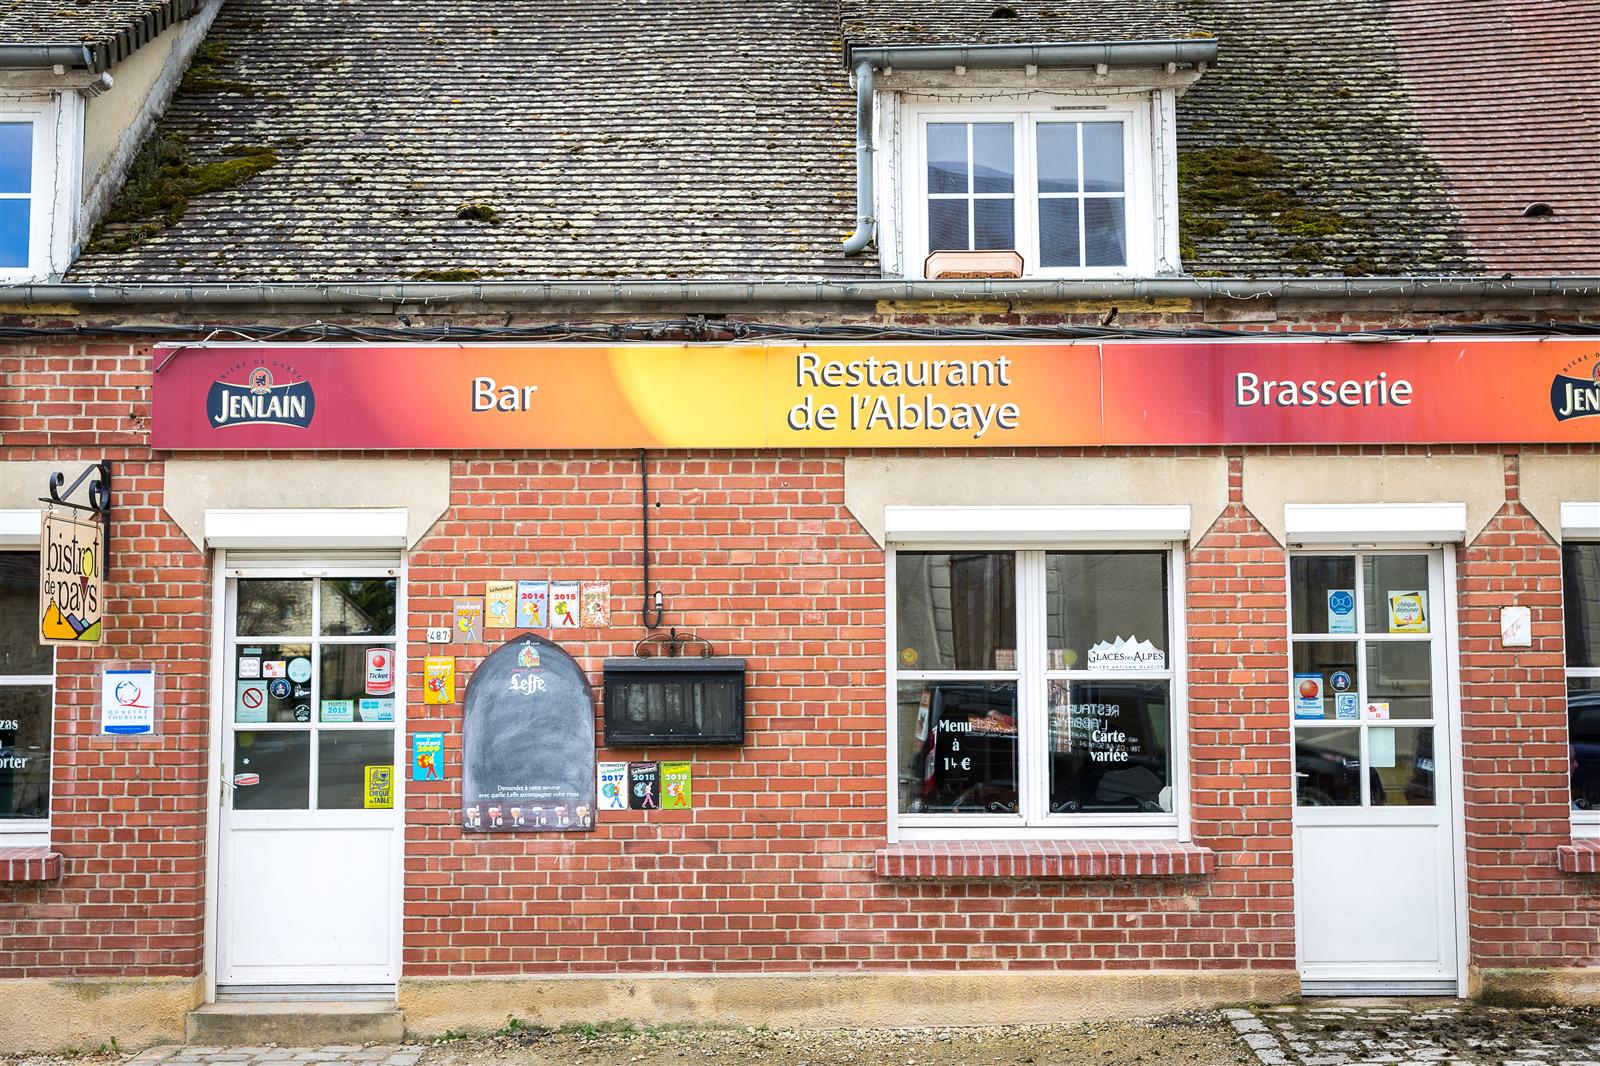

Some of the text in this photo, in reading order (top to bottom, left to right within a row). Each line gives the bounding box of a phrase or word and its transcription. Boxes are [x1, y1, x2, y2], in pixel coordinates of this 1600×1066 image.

[273, 361, 302, 379] GARDE
[796, 352, 1012, 387] Restaurant
[472, 376, 538, 412] Bar
[1235, 372, 1414, 407] Brasserie
[214, 389, 306, 424] JENLAIN
[788, 393, 1020, 439] de l'Abbaye
[46, 525, 100, 578] bistrot
[44, 573, 55, 595] de
[57, 580, 98, 625] pays
[430, 631, 448, 640] 487
[1088, 651, 1124, 663] GLACES
[1134, 651, 1164, 662] ALPES
[509, 673, 547, 695] Leffe
[940, 719, 972, 732] Menu
[1092, 730, 1126, 742] Carte
[952, 738, 960, 751] à
[1090, 748, 1128, 761] variée
[944, 757, 971, 770] 14 €
